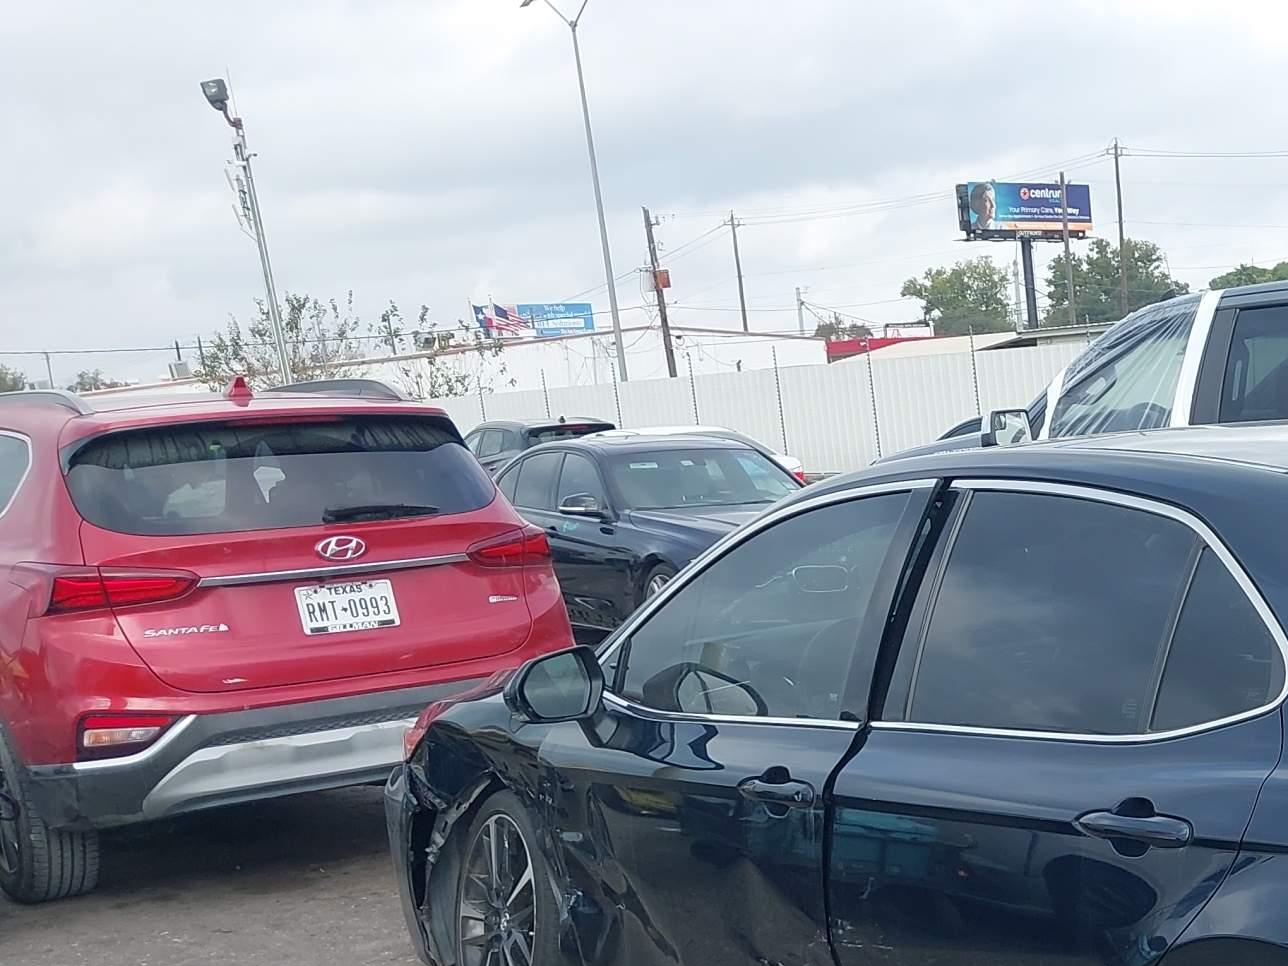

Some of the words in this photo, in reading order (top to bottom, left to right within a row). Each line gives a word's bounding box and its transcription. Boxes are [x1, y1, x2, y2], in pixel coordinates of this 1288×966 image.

[326, 583, 363, 596] TEXAS
[347, 595, 391, 619] 0993
[144, 626, 198, 638] SANTA
